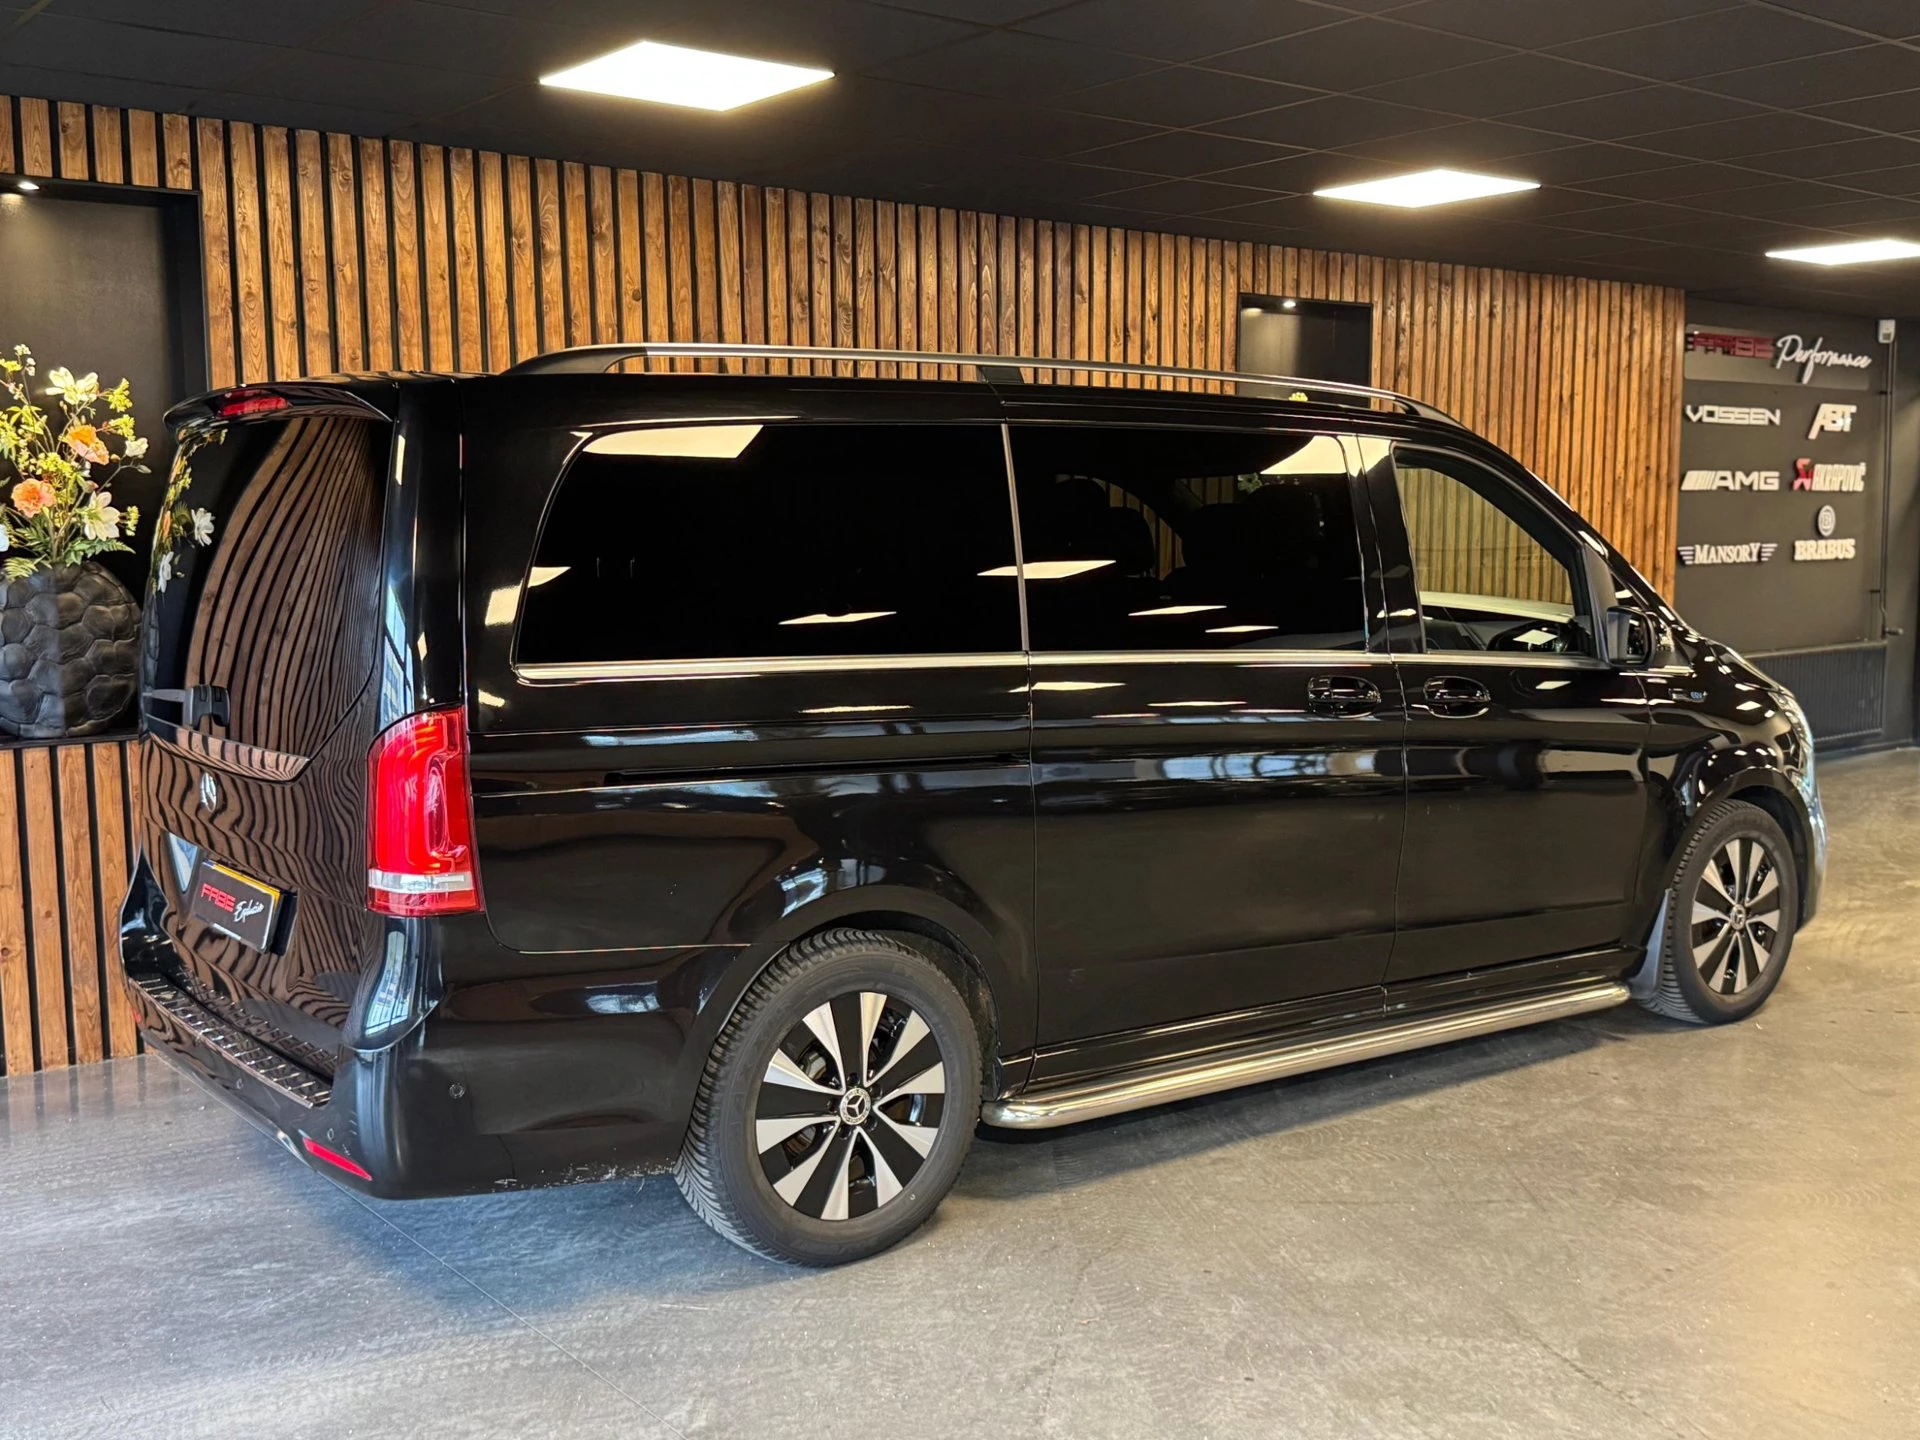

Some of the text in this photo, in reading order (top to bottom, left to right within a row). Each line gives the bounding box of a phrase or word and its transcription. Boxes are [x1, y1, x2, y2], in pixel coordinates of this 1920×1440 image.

[1776, 334, 1872, 385] Performance
[1686, 404, 1781, 426] VOSSEN
[1808, 403, 1857, 440] ABT
[1711, 470, 1780, 491] AMG
[1694, 543, 1761, 564] MANSORY
[1794, 538, 1856, 561] BRABUS
